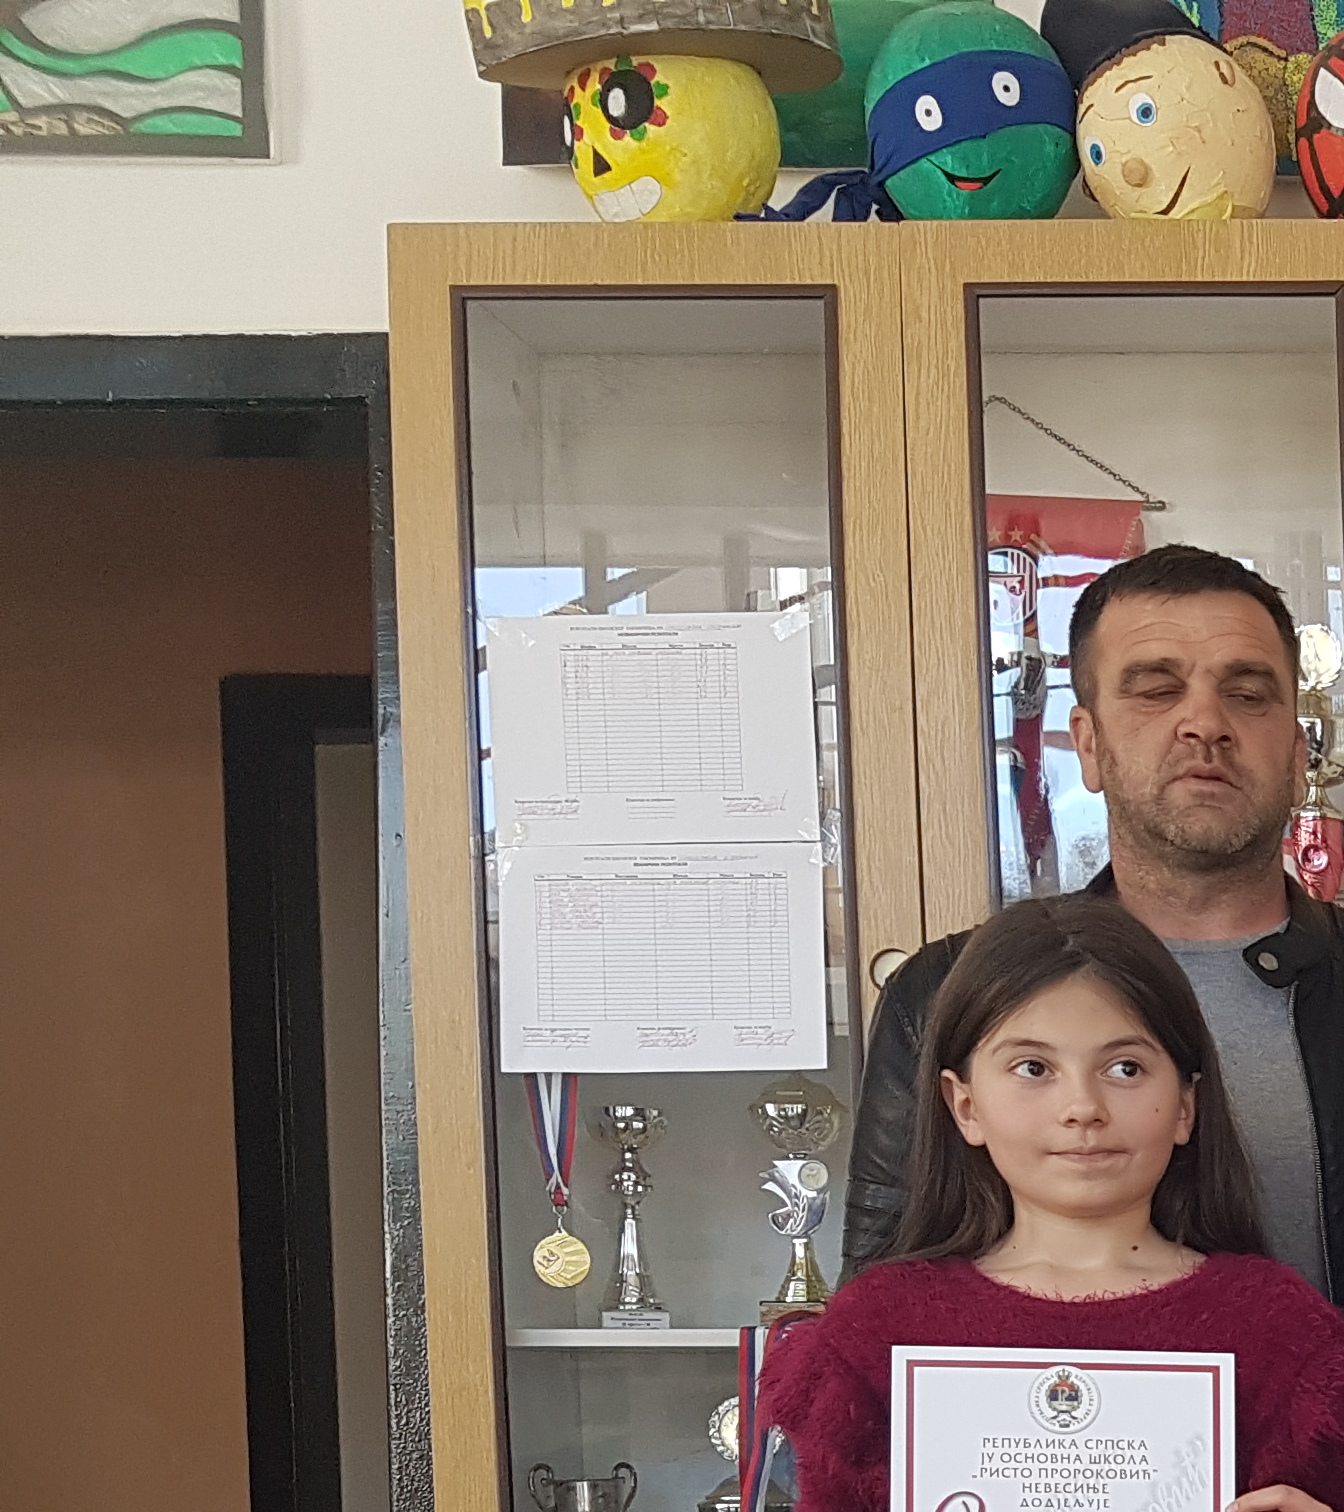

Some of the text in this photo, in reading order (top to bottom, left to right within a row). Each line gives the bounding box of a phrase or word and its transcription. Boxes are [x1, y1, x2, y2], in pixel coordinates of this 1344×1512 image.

[982, 1437, 1149, 1451] РЕПУБЛИКА СРПСКА
[981, 1452, 1150, 1466] ЈУ ОСНОВНА ШКОЛА
[1022, 1482, 1110, 1495] НЕВЕСИЊЕ
[1019, 1497, 1110, 1511] ДОДЈЕЉУЈЕ
